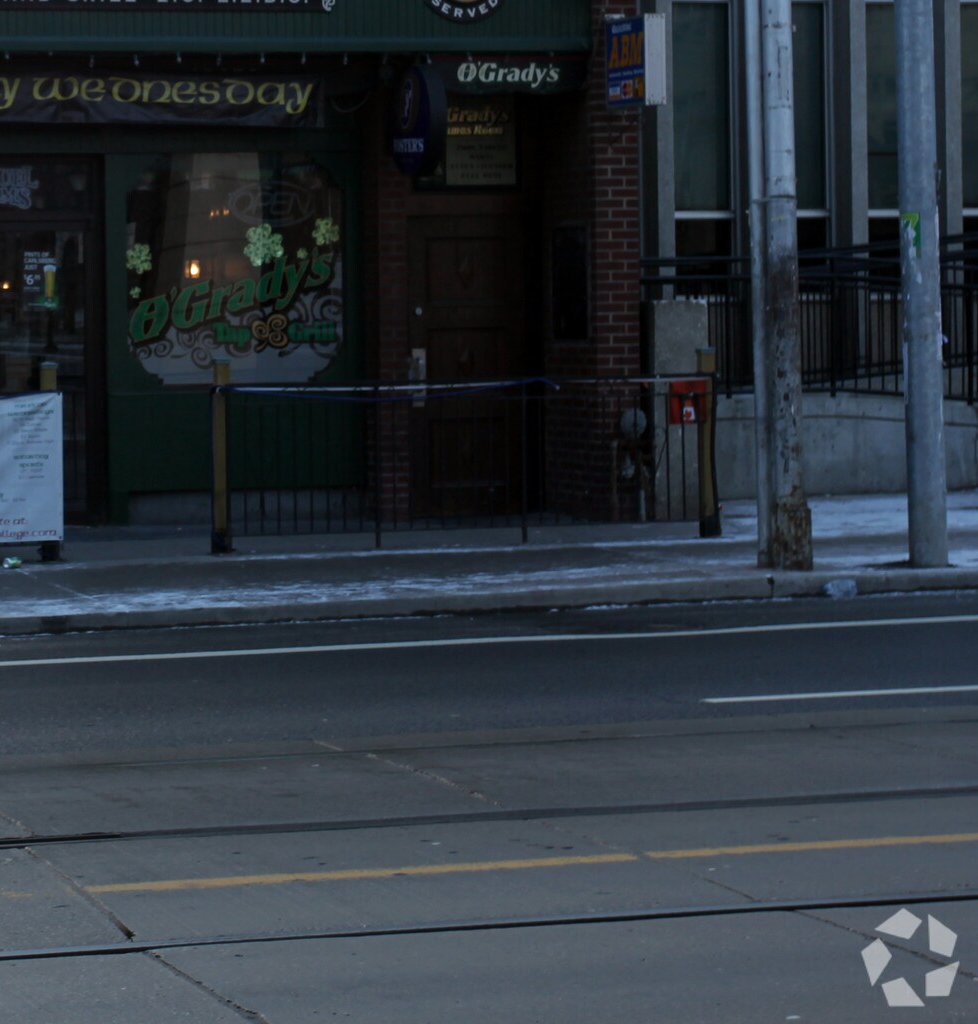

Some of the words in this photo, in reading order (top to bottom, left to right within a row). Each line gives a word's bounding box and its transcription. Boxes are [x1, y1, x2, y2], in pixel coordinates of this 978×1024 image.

[608, 31, 644, 69] ABM
[457, 62, 561, 88] O'Grady's
[447, 106, 509, 126] Grady's
[234, 190, 312, 216] OPEN
[129, 246, 334, 344] O'Grady's
[288, 321, 337, 343] Grill
